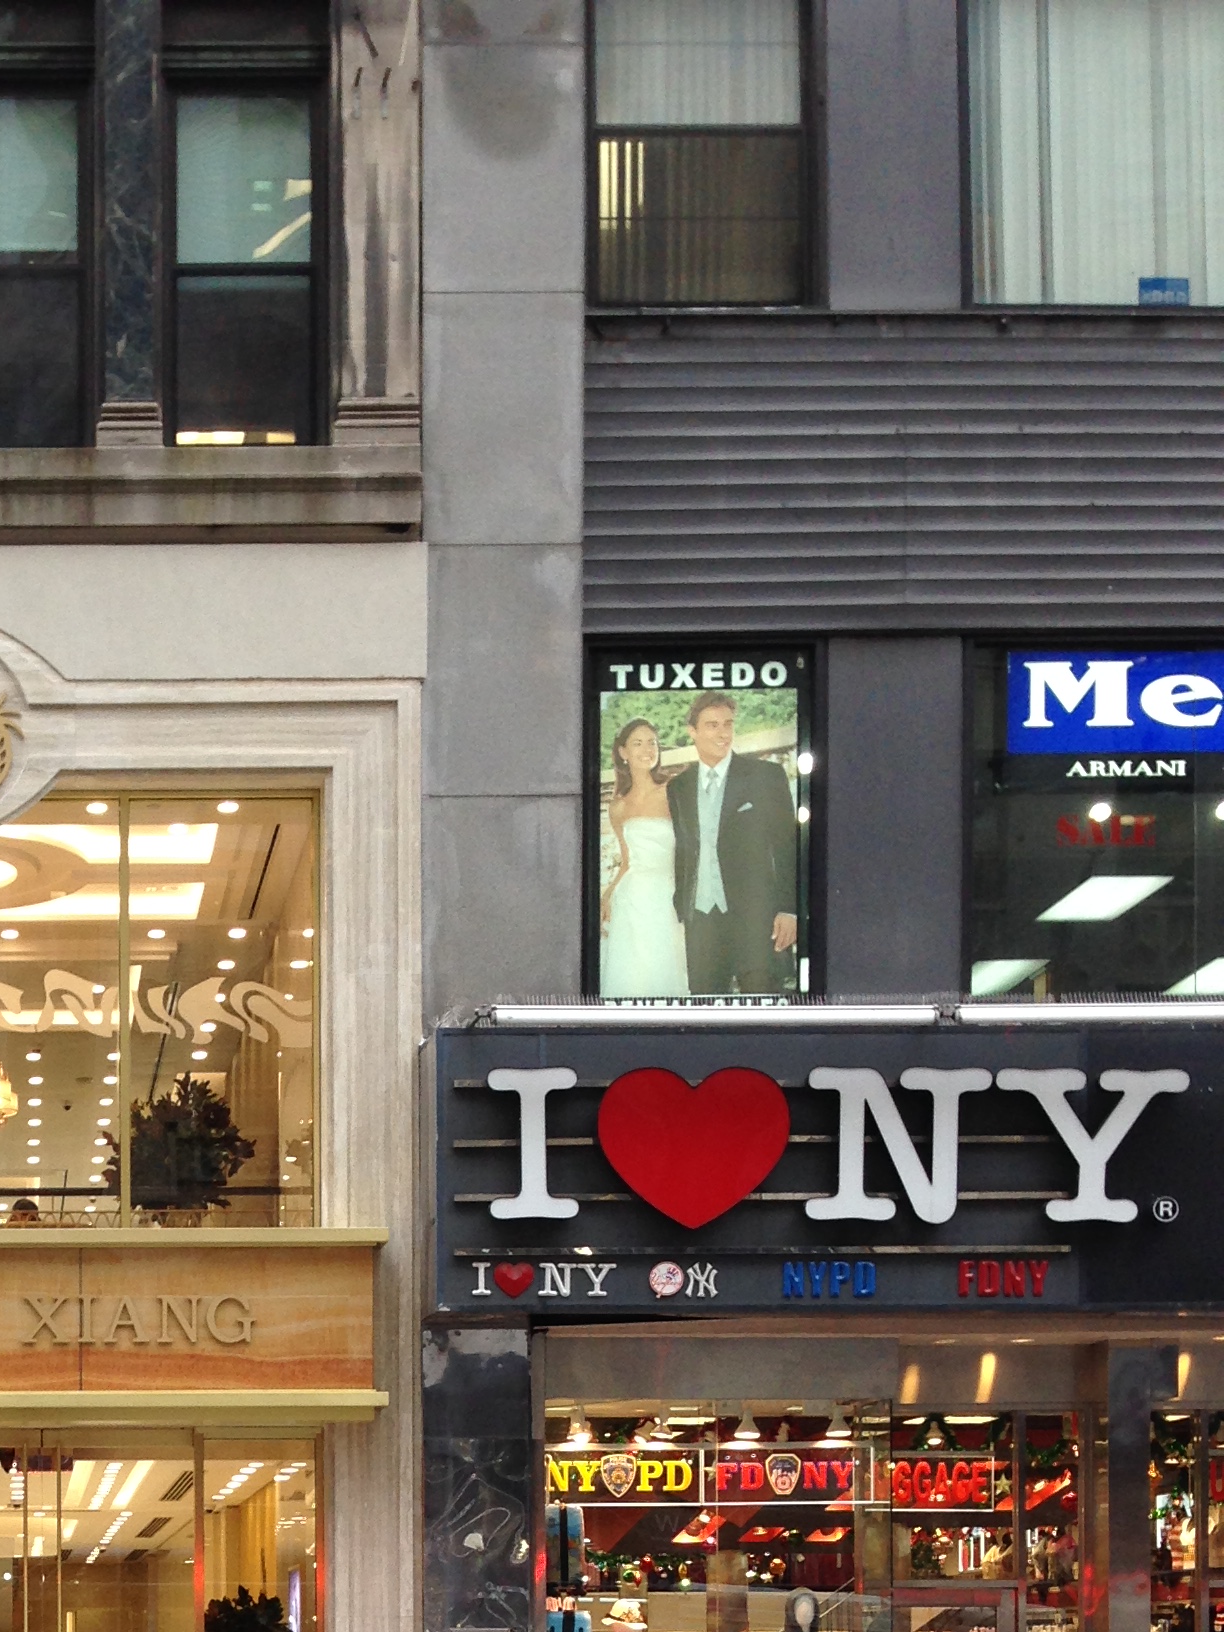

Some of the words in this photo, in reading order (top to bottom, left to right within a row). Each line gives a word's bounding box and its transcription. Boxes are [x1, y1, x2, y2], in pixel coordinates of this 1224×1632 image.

[609, 660, 788, 690] TUXEDO
[1022, 660, 1224, 728] Me
[1066, 760, 1187, 777] ARMANI
[1056, 814, 1155, 847] SALE
[487, 1067, 579, 1220] I
[805, 1067, 1190, 1224] NY
[471, 1262, 491, 1296] I
[538, 1262, 617, 1297] NY
[782, 1260, 875, 1298] NYPD
[957, 1260, 1049, 1298] FDNY
[22, 1294, 257, 1344] XIANG
